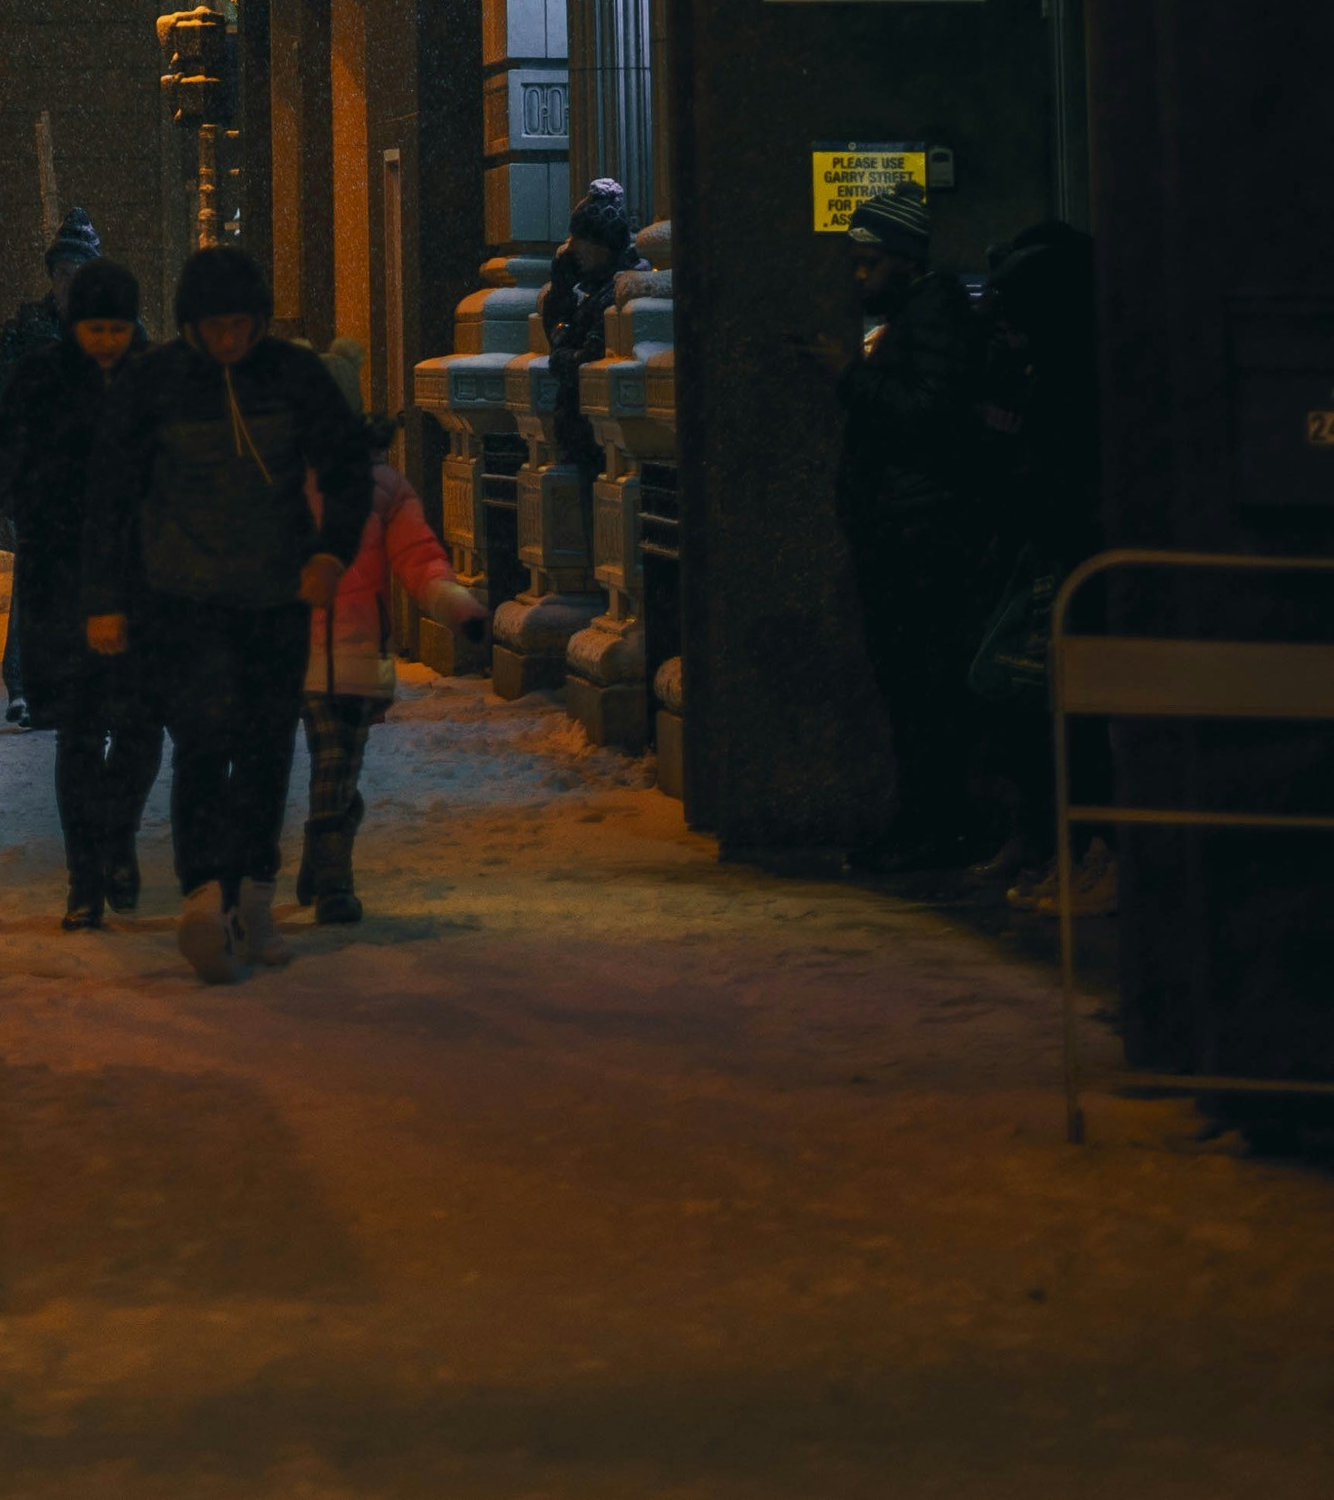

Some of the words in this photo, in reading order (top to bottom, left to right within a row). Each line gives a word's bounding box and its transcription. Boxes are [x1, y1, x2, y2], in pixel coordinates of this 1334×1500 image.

[832, 157, 878, 169] PLEASE
[882, 157, 905, 169] USE
[824, 171, 867, 183] GARRY
[869, 171, 914, 183] STREET
[837, 185, 899, 197] ENTRANC
[828, 199, 852, 211] FOR
